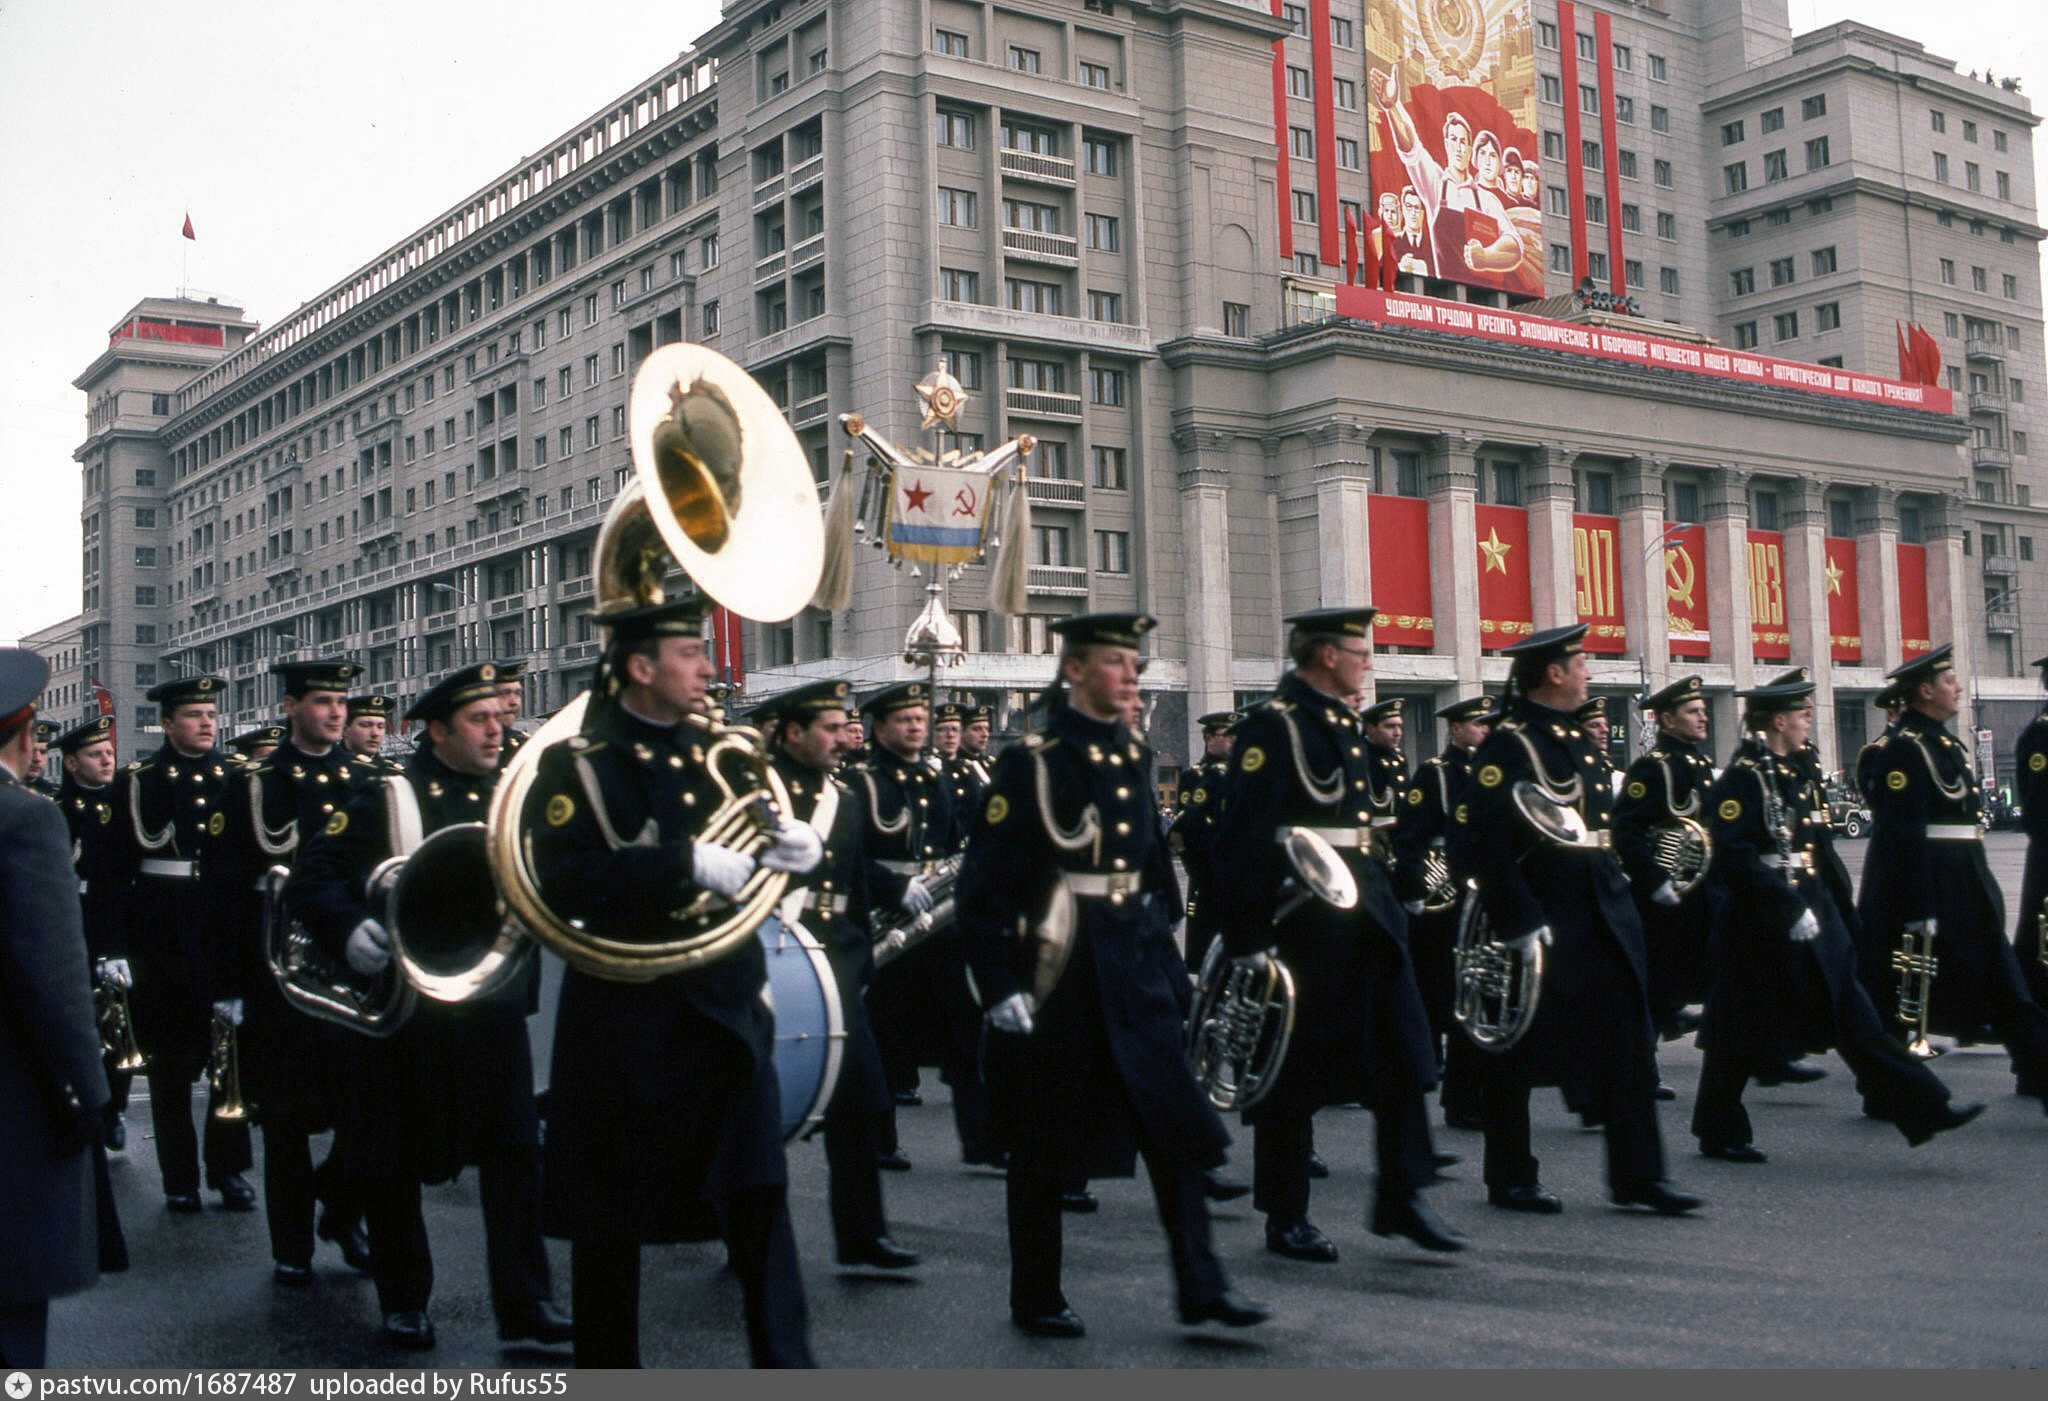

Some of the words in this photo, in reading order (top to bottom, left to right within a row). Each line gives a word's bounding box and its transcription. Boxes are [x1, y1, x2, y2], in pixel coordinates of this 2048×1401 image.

[1386, 298, 1433, 322] УДАРНЫМ
[1435, 306, 1473, 328] ТРУДОМ
[1477, 313, 1516, 336] КРЕПИТЬ
[1519, 321, 1590, 348] ЭКОНОМИЧЕСКОЕ
[1592, 333, 1599, 350] И
[1601, 334, 1648, 357] ОБОРОННОЕ
[1650, 343, 1700, 366] МОГУЩЕСТВО
[1703, 352, 1730, 371] НАШЕЙ
[1733, 357, 1763, 377] РОДИНЫ
[1773, 364, 1832, 388] ПАТРИОТИЧЕСКИЙ
